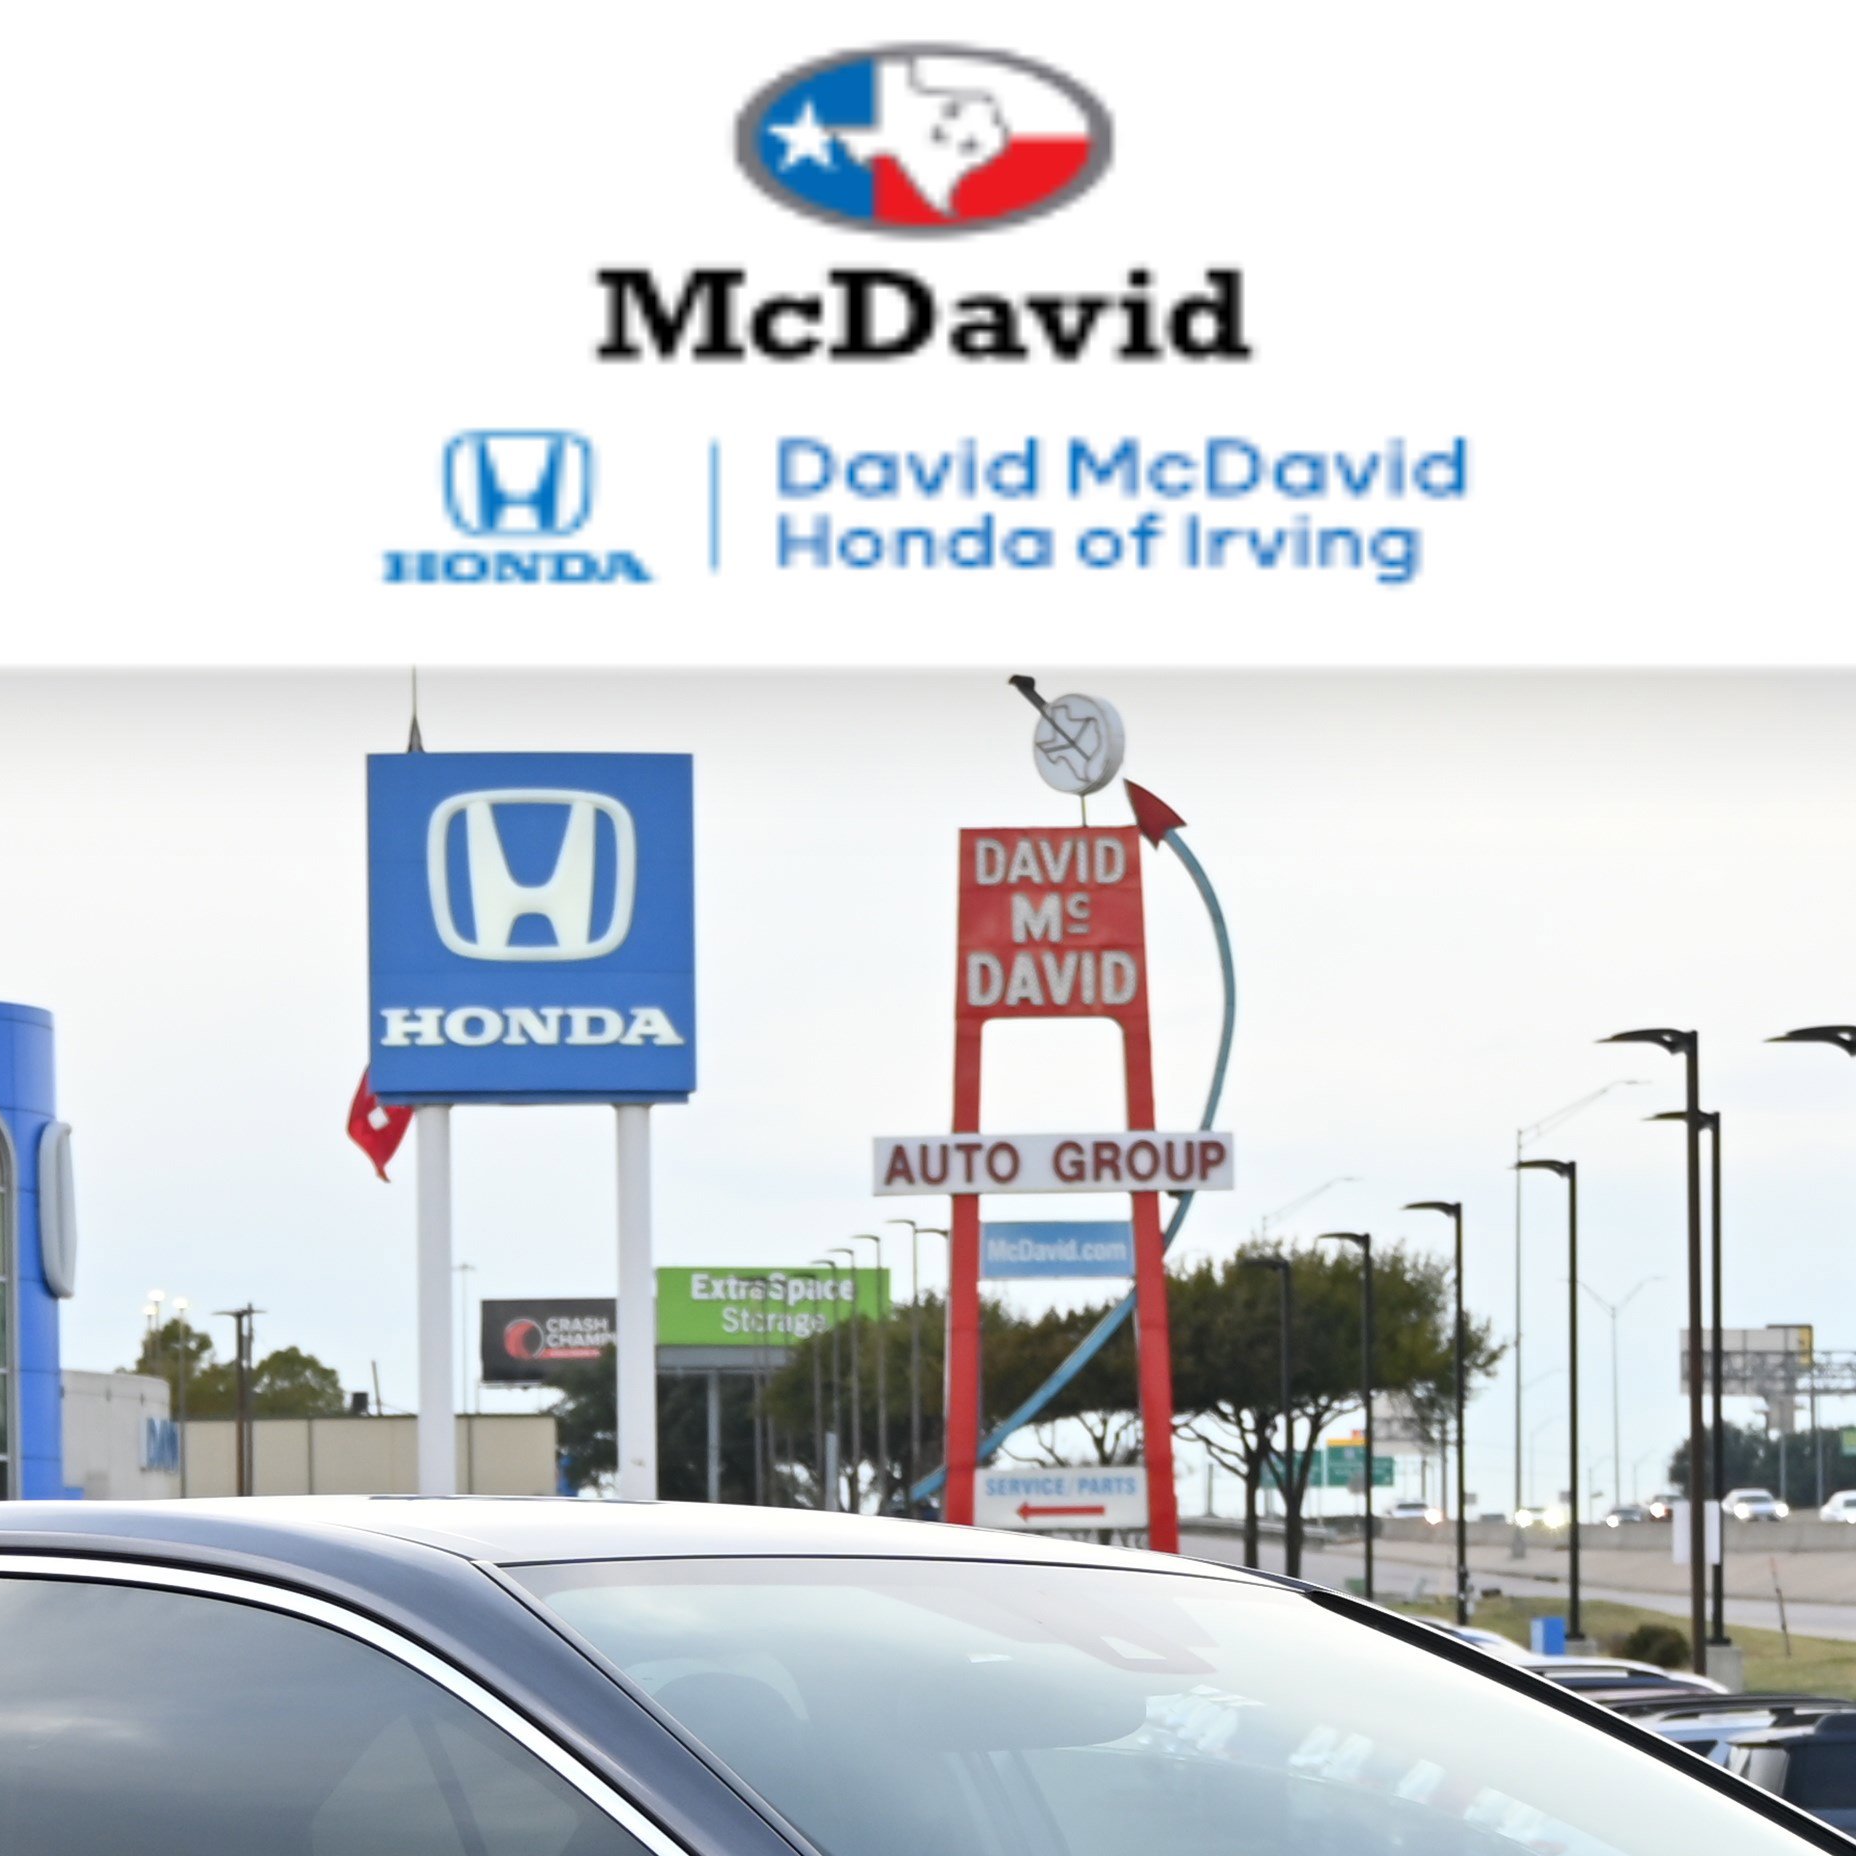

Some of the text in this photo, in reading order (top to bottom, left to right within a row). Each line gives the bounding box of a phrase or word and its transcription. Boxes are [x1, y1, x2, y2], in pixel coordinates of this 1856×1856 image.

[975, 837, 1127, 886] DAVID
[967, 950, 1138, 1007] DAVID
[380, 1006, 685, 1047] HONDA
[884, 1139, 1227, 1186] AUTO GROUP
[987, 1238, 1127, 1263] McDavid.com
[545, 1317, 609, 1332] CRASH
[722, 1306, 827, 1338] Storage
[986, 1477, 1136, 1496] SERVICE PARTS
